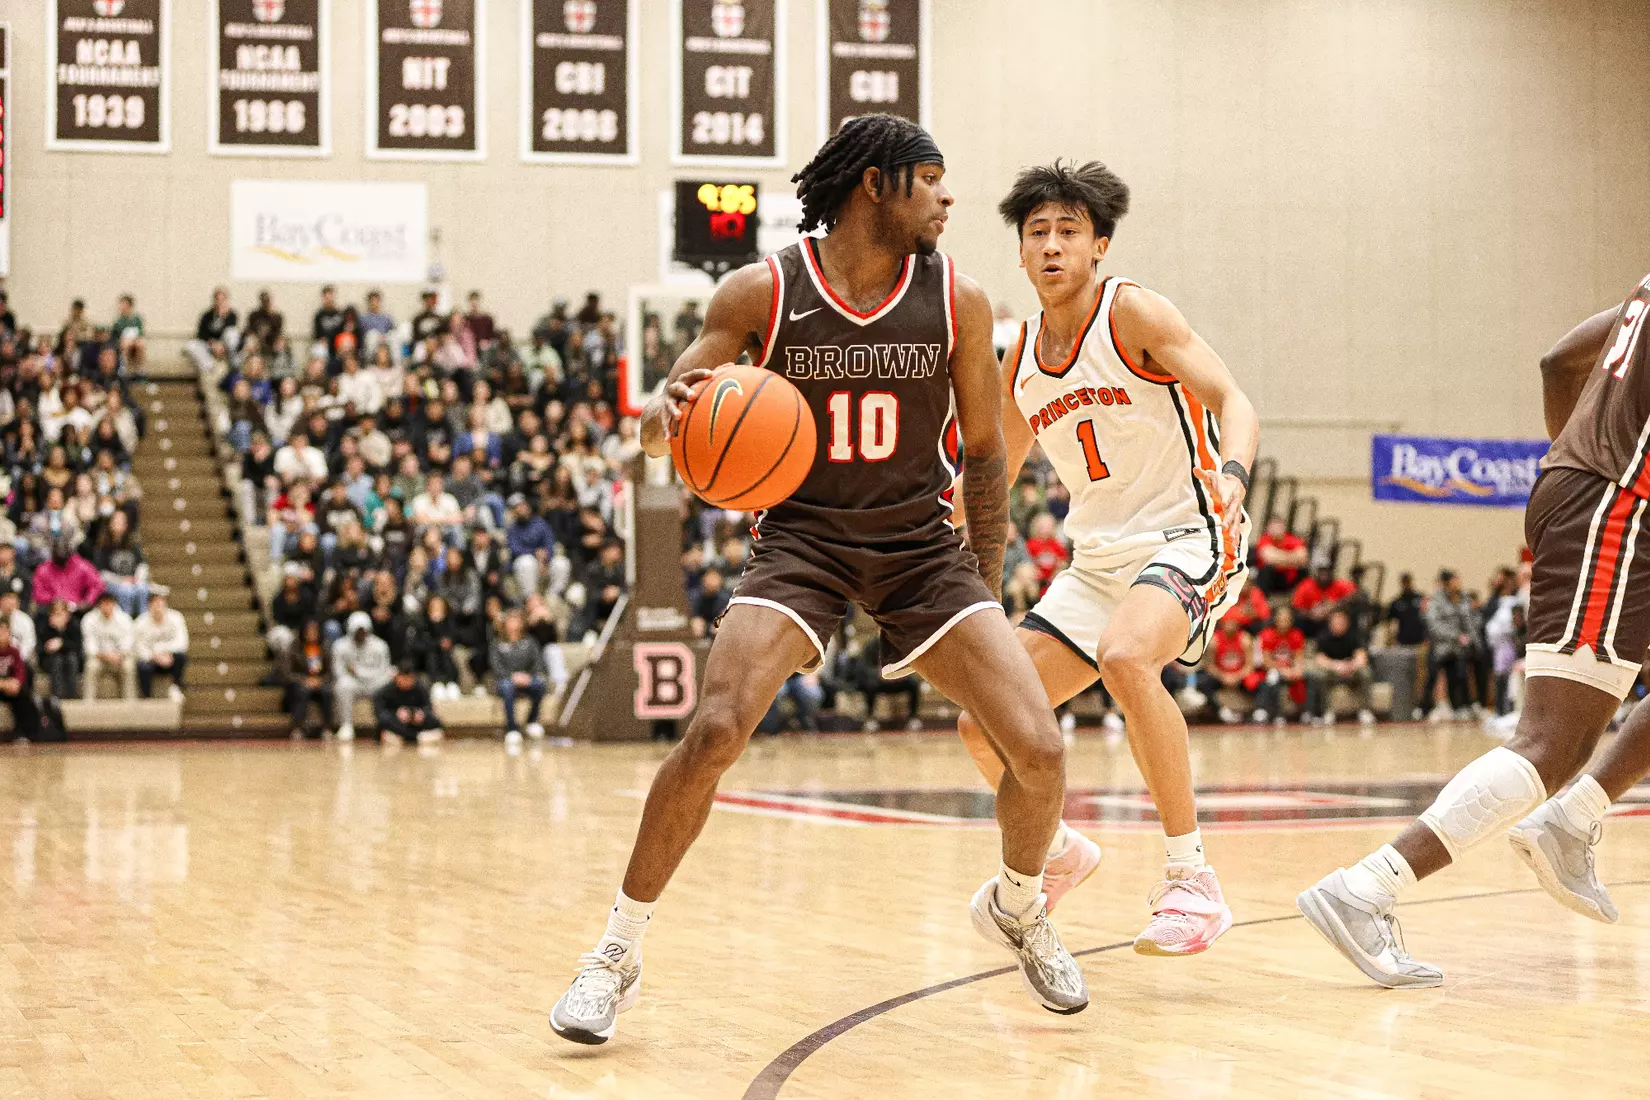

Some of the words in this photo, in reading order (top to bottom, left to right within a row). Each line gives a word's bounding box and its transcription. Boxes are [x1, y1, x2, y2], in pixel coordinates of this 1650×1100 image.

[75, 38, 141, 66] NCAA
[73, 94, 145, 129] 1939
[785, 344, 941, 380] BROWN
[826, 390, 900, 463] 10
[1029, 387, 1133, 437] PRINCETON
[1076, 418, 1111, 483] 1
[1391, 443, 1538, 490] BayCoast
[633, 642, 697, 720] B
